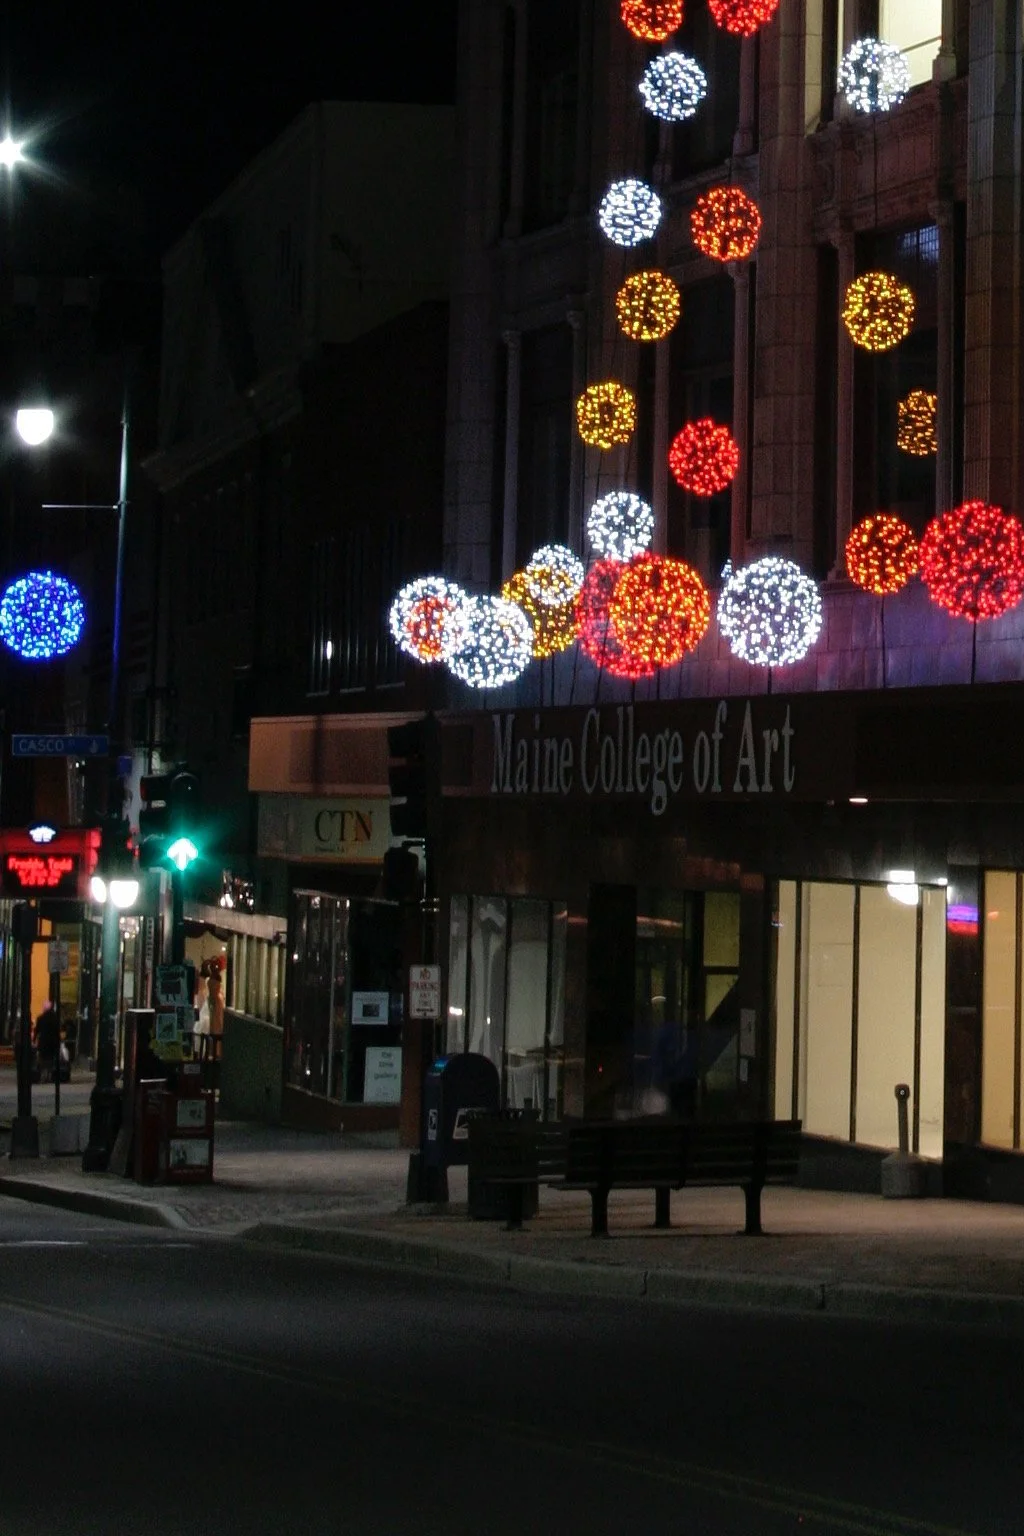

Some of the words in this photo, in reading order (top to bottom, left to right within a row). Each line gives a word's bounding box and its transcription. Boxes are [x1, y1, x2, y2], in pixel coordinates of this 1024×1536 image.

[18, 739, 65, 752] CASCO
[490, 714, 574, 795] Maine
[580, 708, 684, 816] College
[693, 700, 728, 794] of
[732, 700, 796, 793] Art
[315, 810, 373, 842] CTN
[420, 968, 430, 980] NO
[410, 981, 439, 991] PARKING
